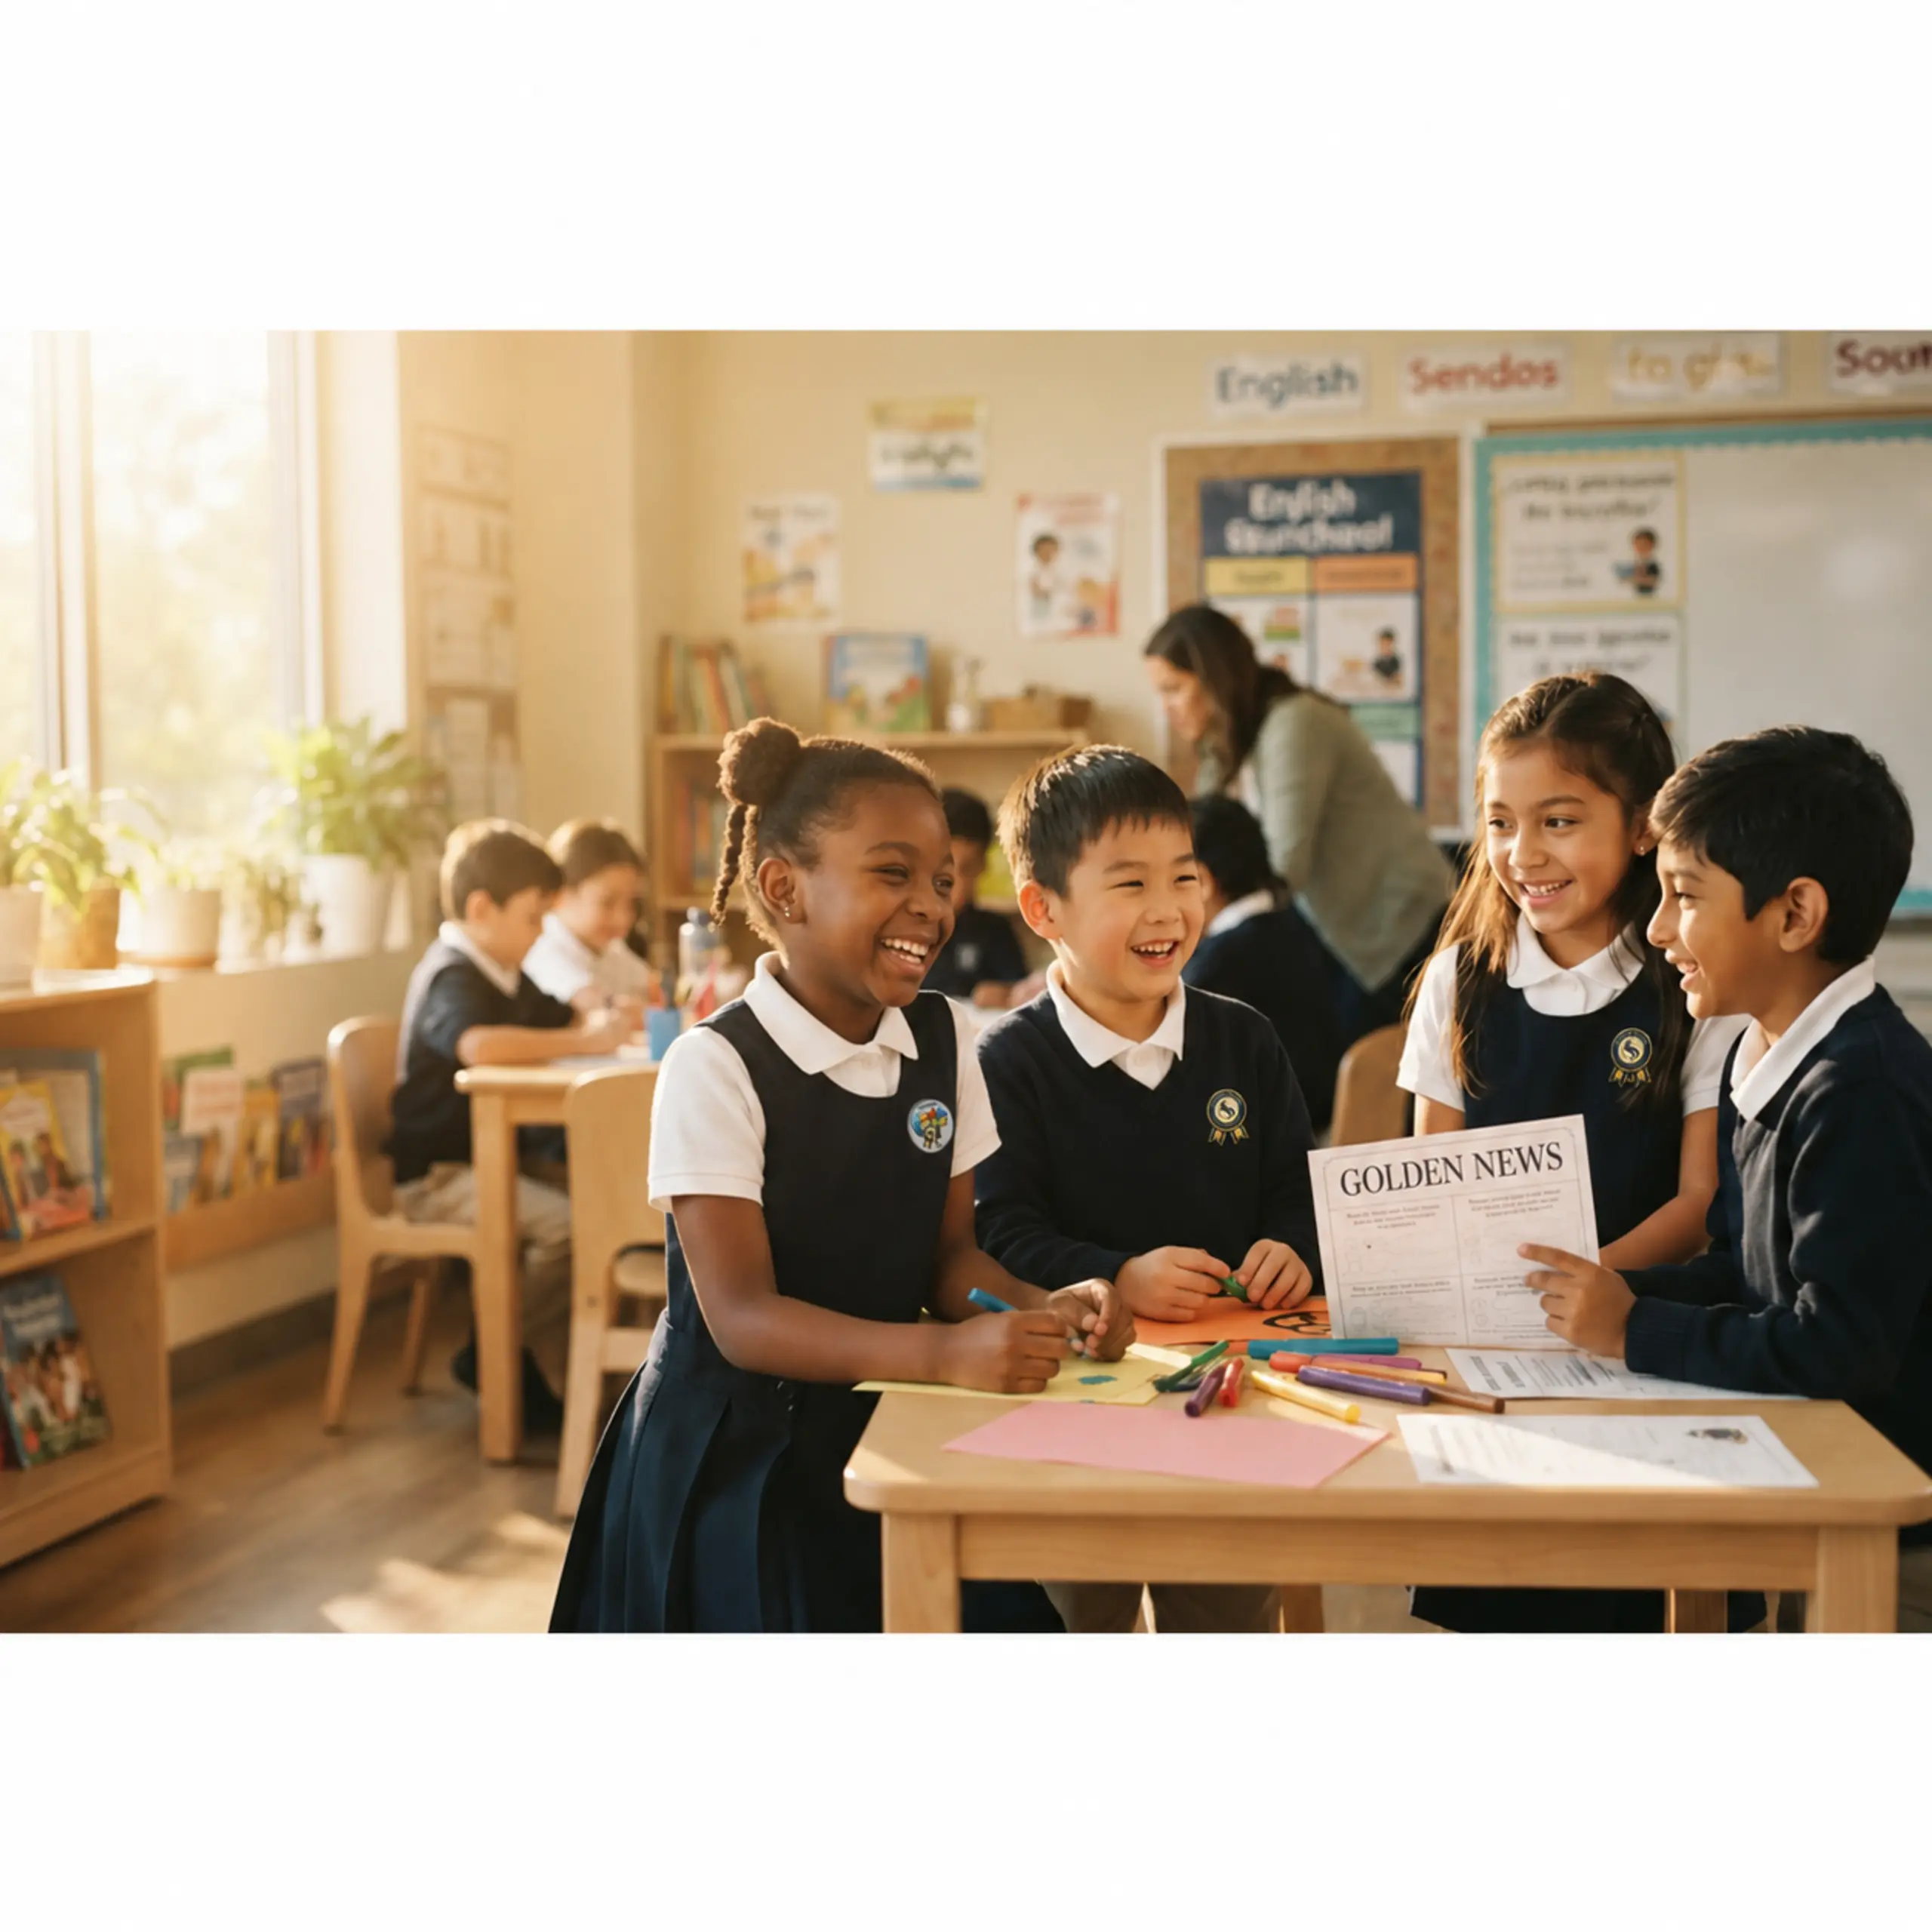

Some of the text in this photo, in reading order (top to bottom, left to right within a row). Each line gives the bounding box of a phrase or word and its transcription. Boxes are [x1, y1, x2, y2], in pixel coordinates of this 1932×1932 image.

[1215, 364, 1358, 411] English
[1340, 1141, 1564, 1197] GOLDEN NEWS
